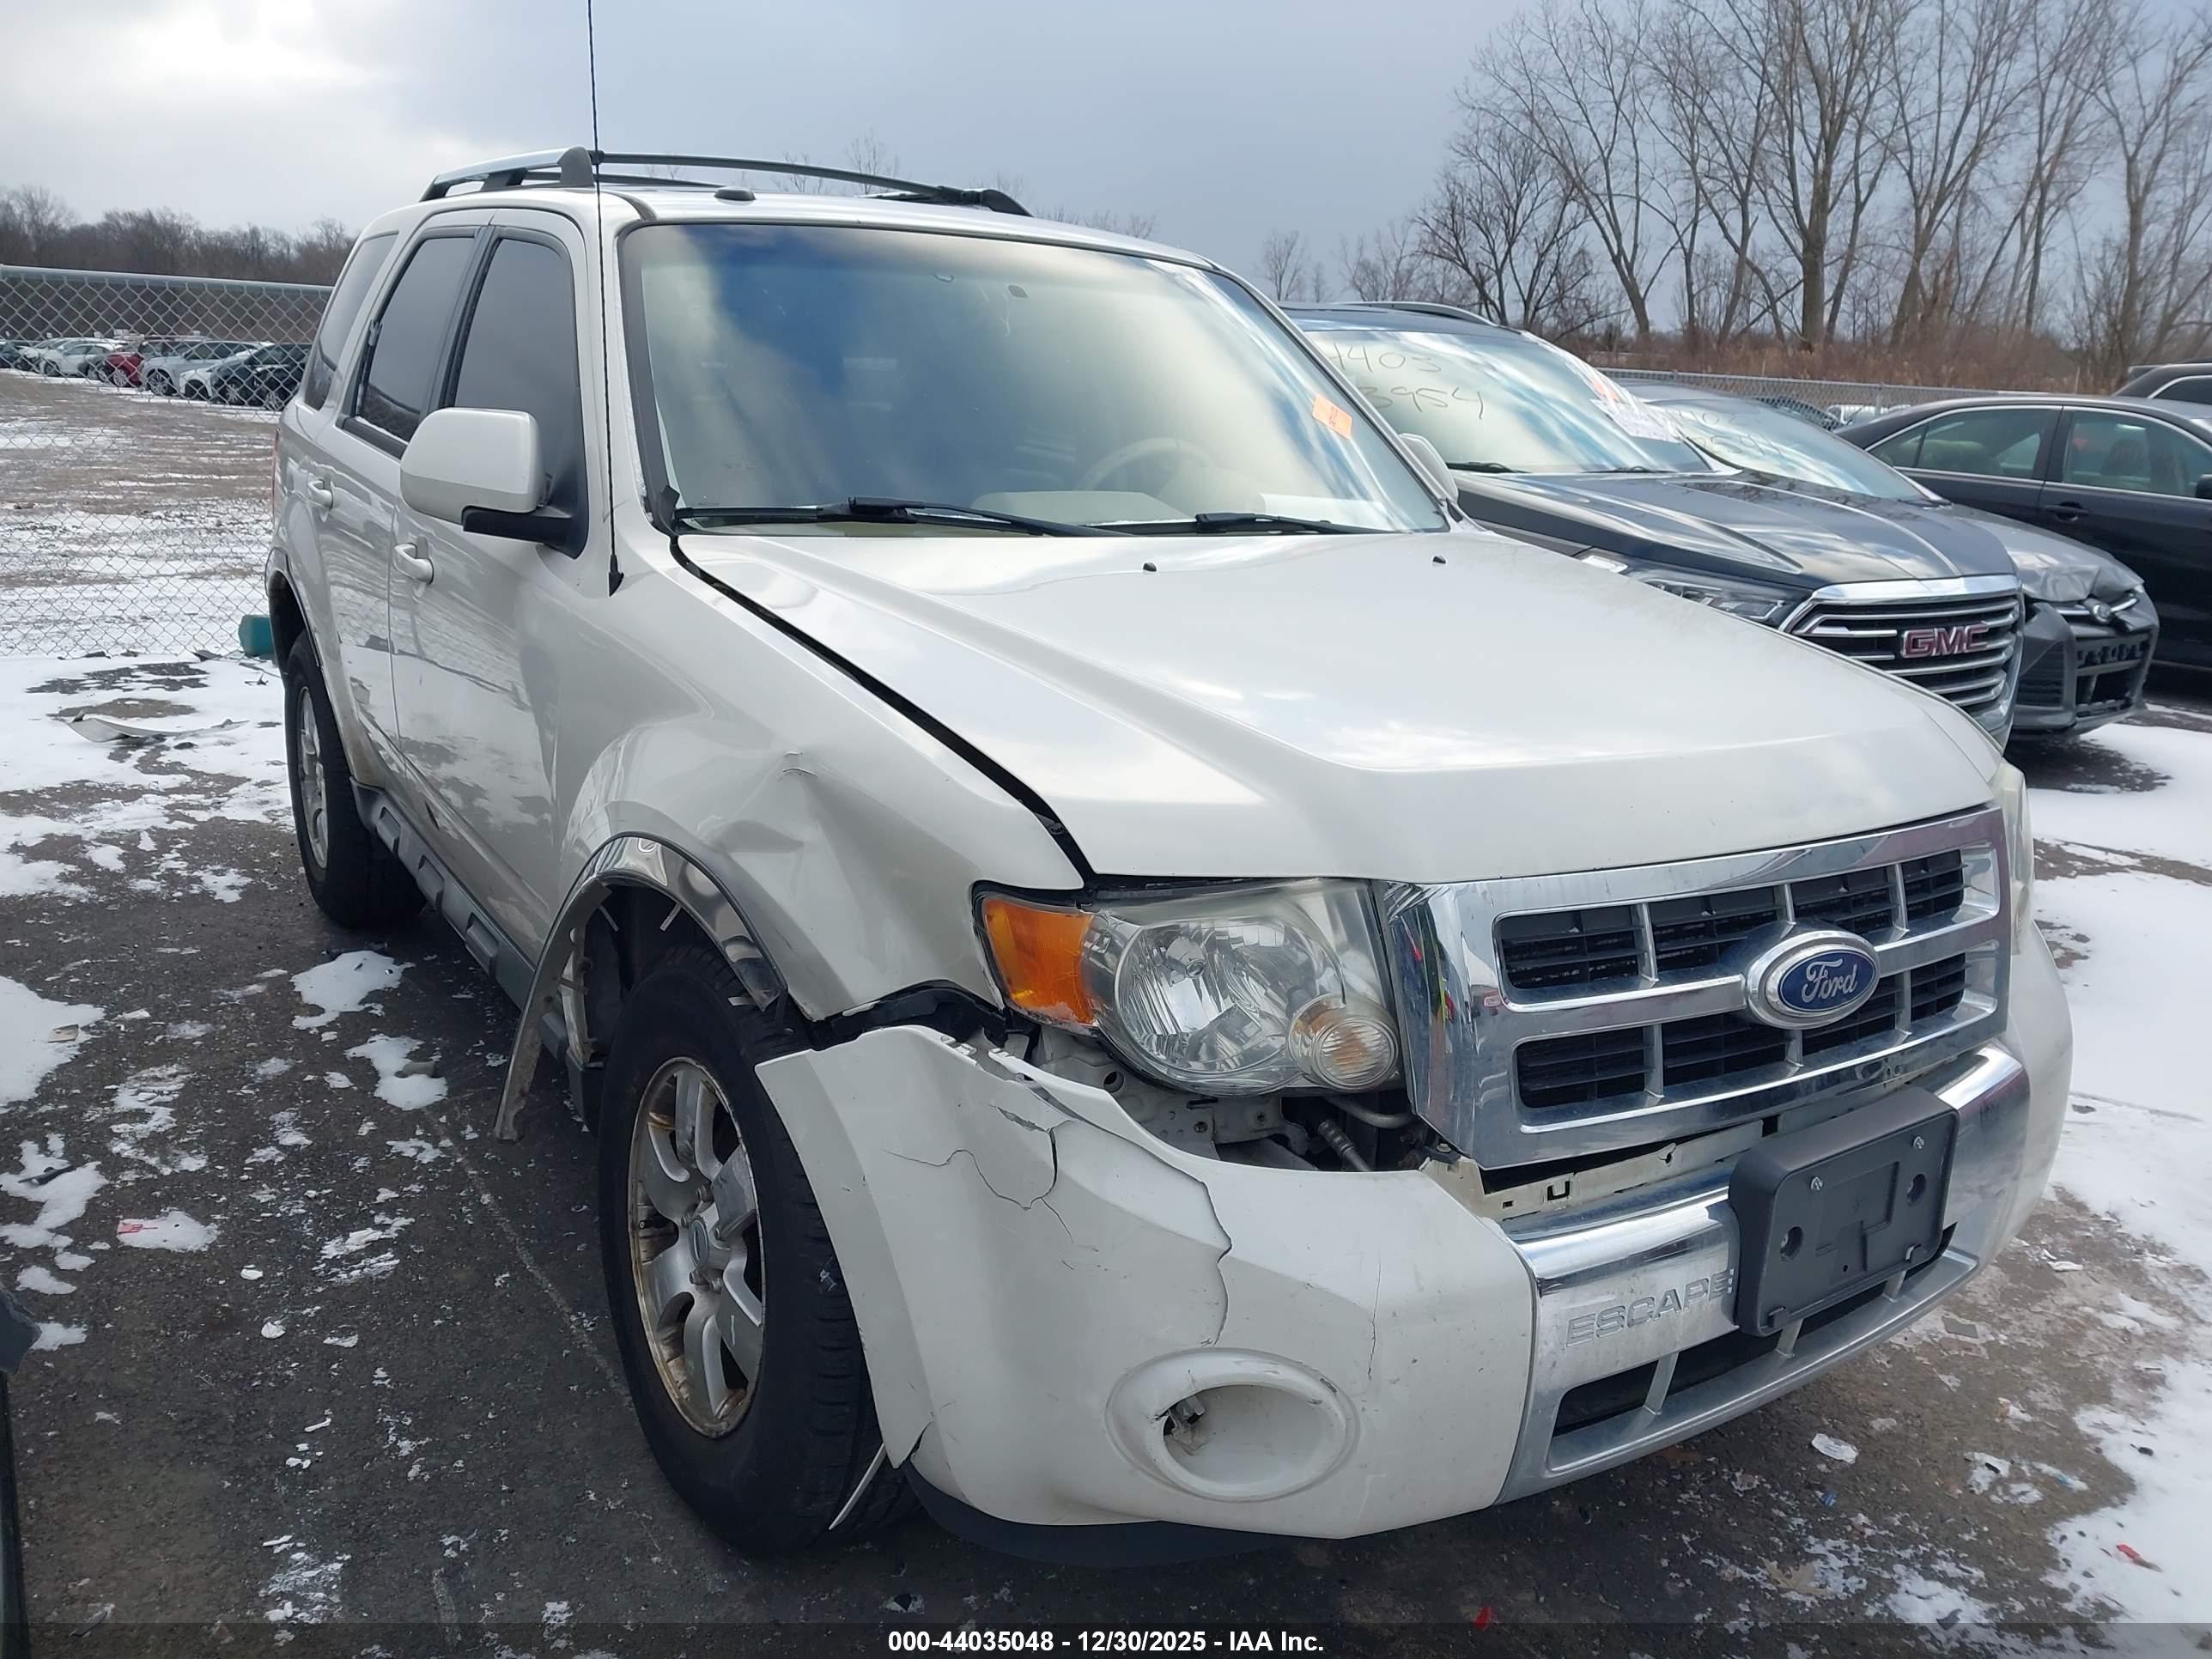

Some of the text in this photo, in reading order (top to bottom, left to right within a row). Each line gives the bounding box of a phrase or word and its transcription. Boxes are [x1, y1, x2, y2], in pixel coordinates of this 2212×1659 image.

[1901, 621, 1989, 659] GMC
[1801, 957, 1858, 1003] Ford
[1565, 1268, 1735, 1348] ESCAPE
